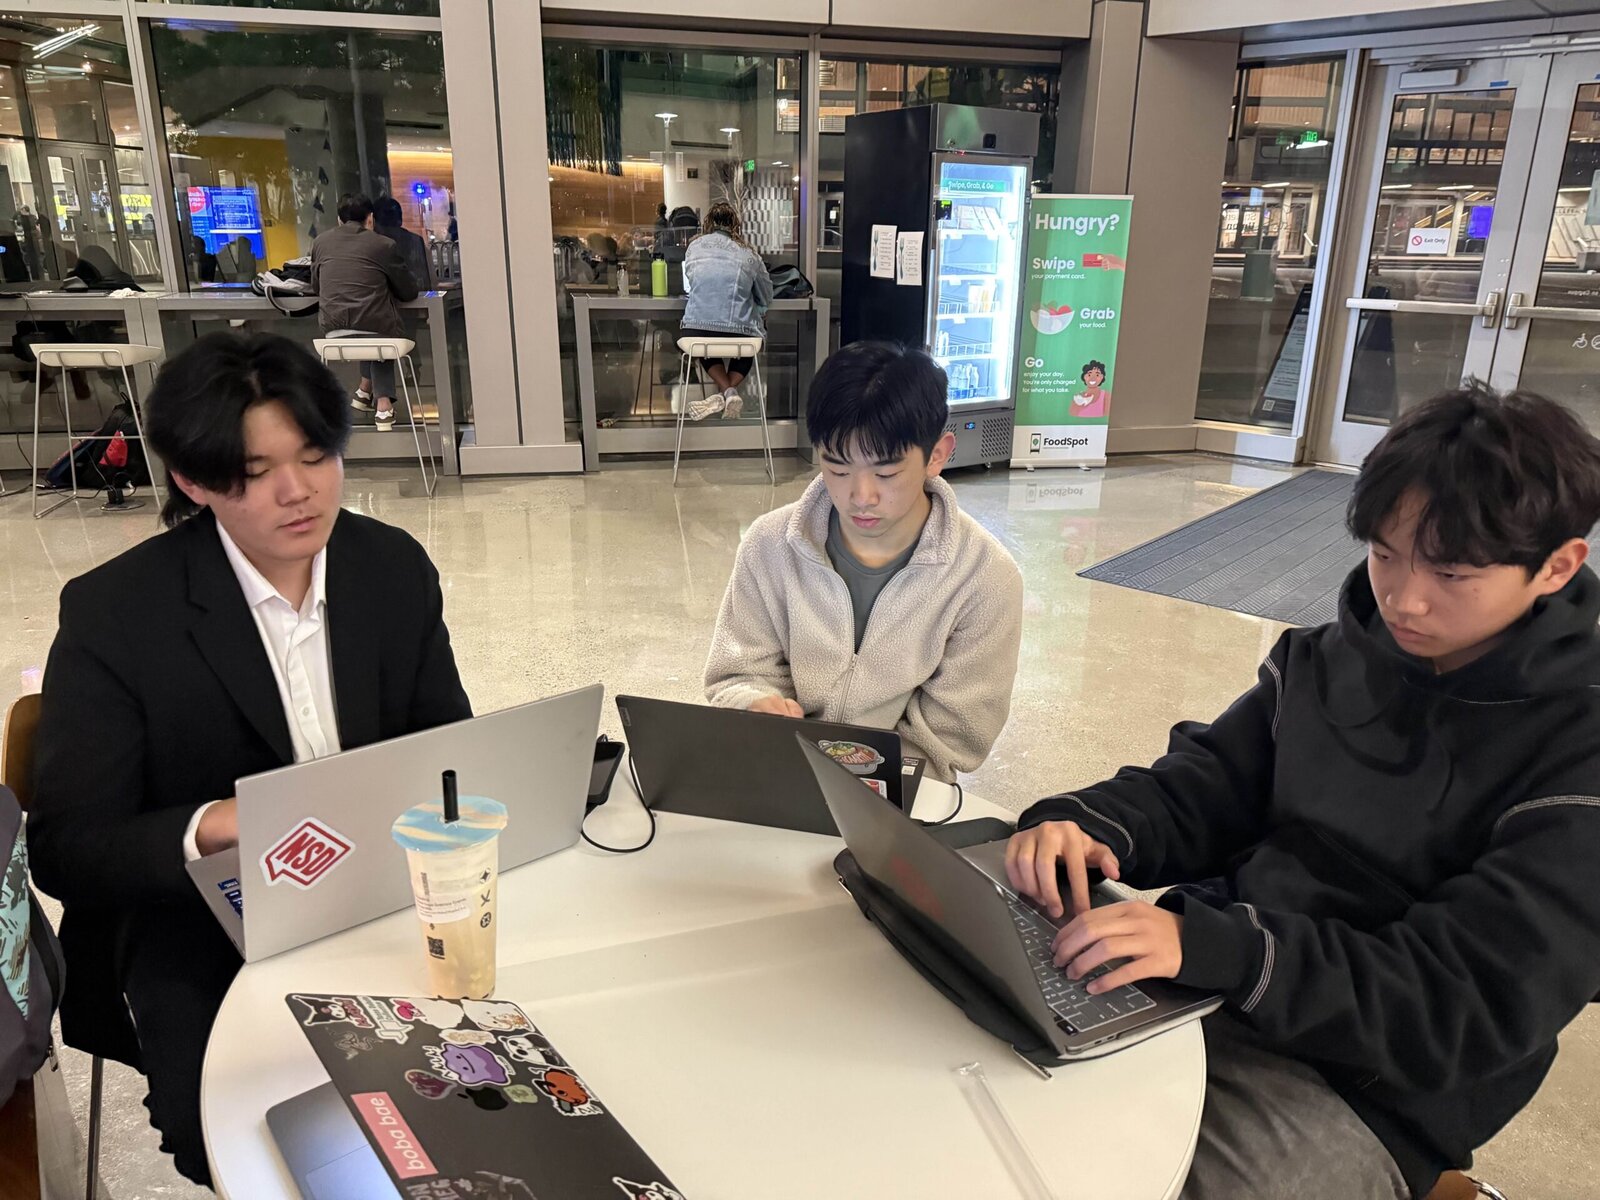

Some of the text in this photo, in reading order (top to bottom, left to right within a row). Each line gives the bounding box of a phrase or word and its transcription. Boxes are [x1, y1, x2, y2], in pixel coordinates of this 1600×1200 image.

[948, 181, 966, 190] Swipe,
[966, 182, 981, 190] Grab,
[1035, 214, 1120, 236] Hungry?
[1032, 256, 1075, 273] Swipe
[1080, 307, 1115, 320] Grab
[1025, 356, 1044, 368] Go
[1043, 437, 1088, 448] FoodSpot
[275, 832, 337, 876] NSD
[370, 1097, 426, 1170] boba bae
